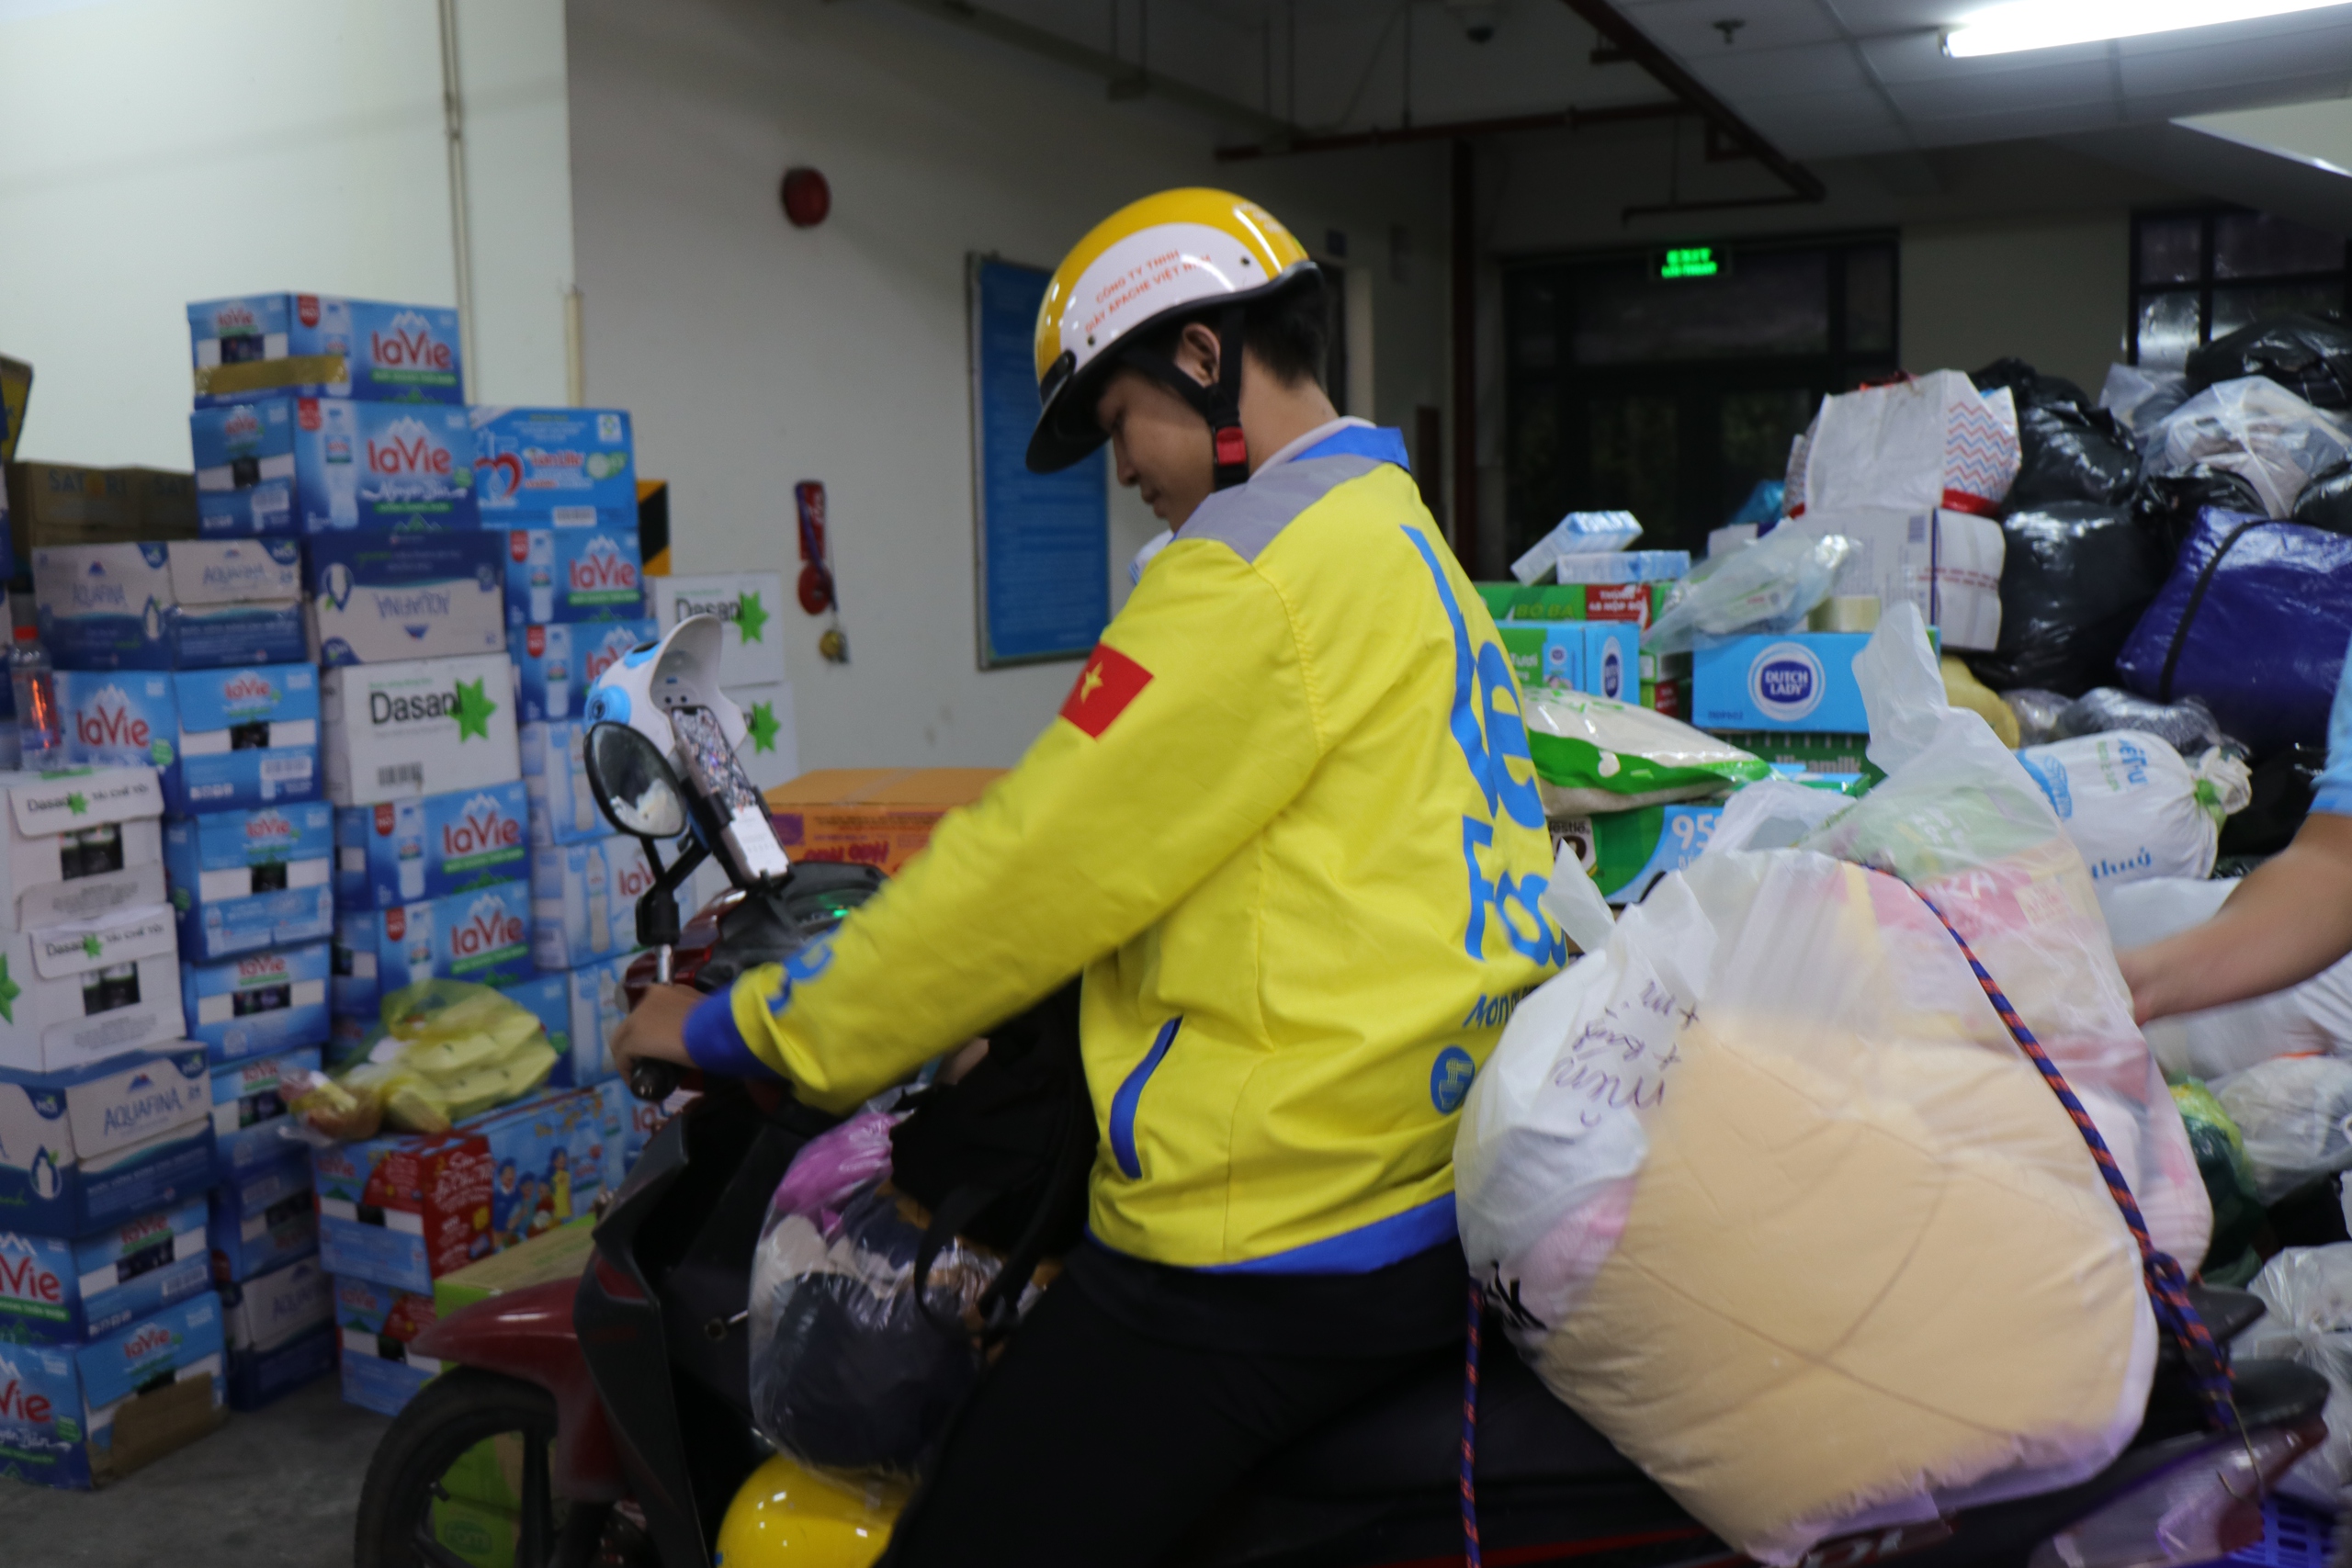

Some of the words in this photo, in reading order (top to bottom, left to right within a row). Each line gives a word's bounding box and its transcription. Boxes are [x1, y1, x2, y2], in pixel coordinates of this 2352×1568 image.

[1765, 670, 1809, 684] DUTCH
[1770, 682, 1803, 696] LADY
[1671, 813, 1723, 852] 95
